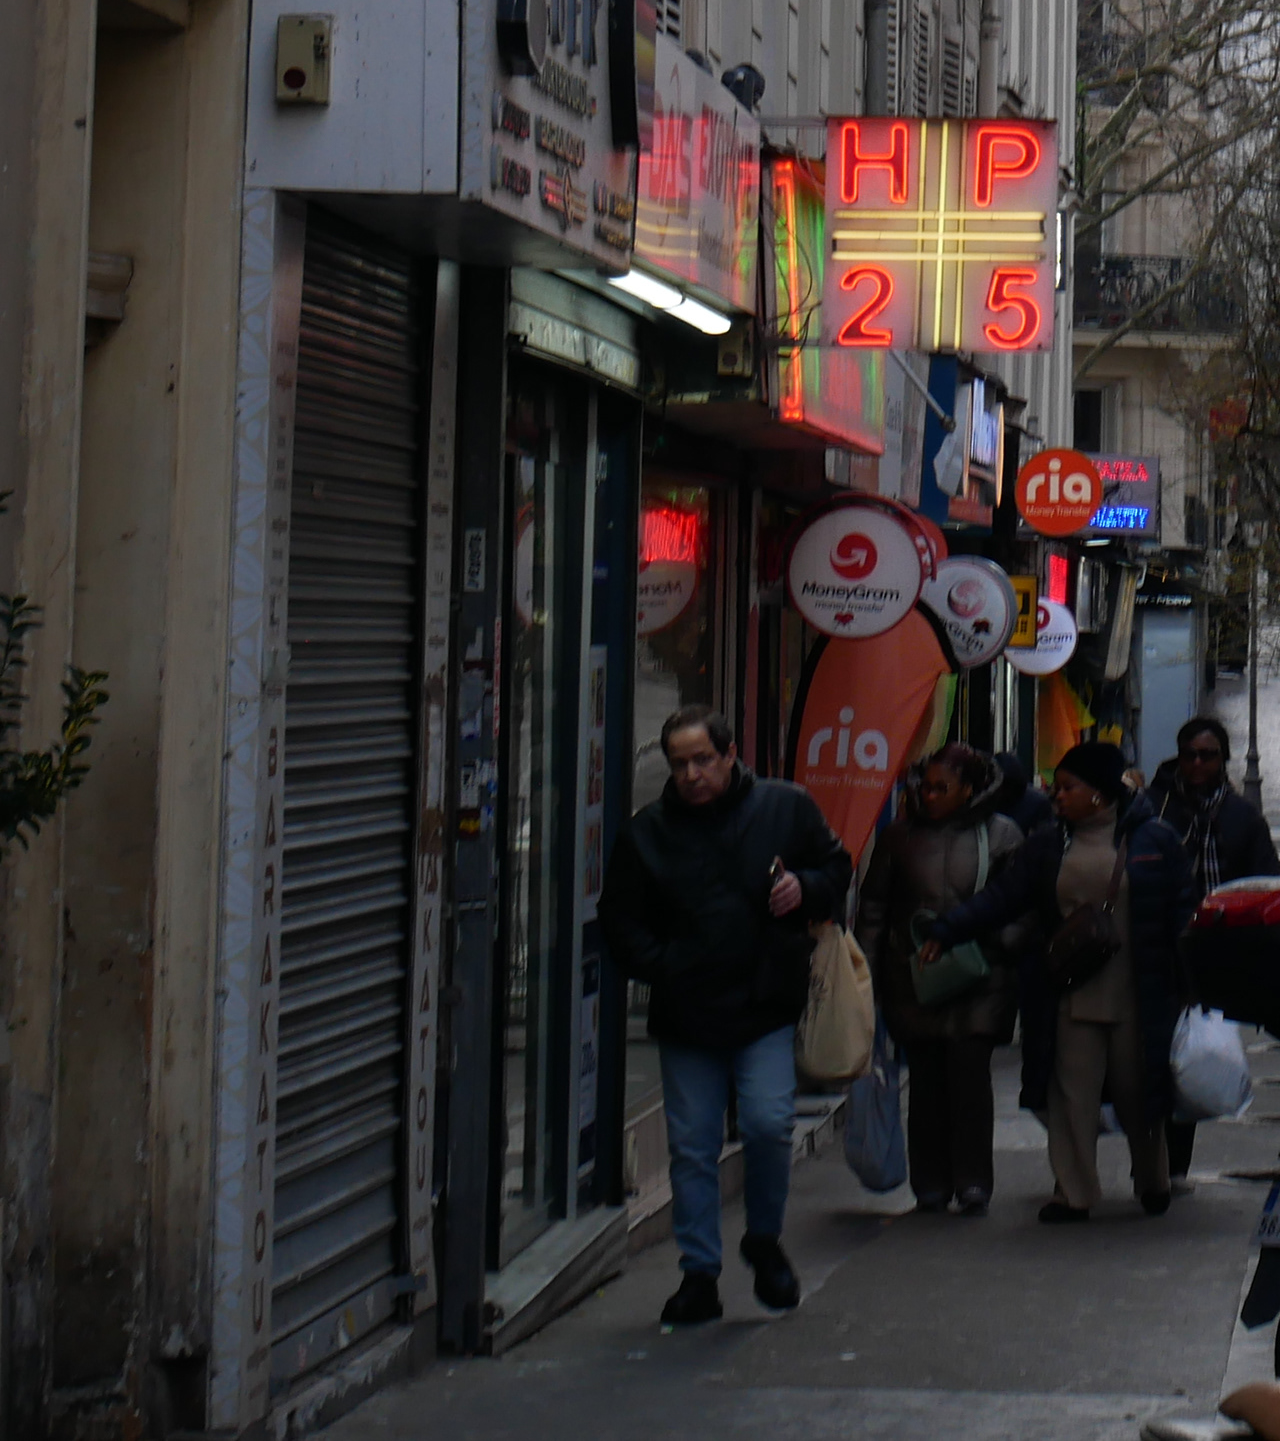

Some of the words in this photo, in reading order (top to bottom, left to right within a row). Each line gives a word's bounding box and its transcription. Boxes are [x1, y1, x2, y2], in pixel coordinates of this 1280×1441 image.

[1025, 458, 1092, 504] ria
[801, 580, 900, 602] MoneyGram
[807, 705, 890, 772] ria
